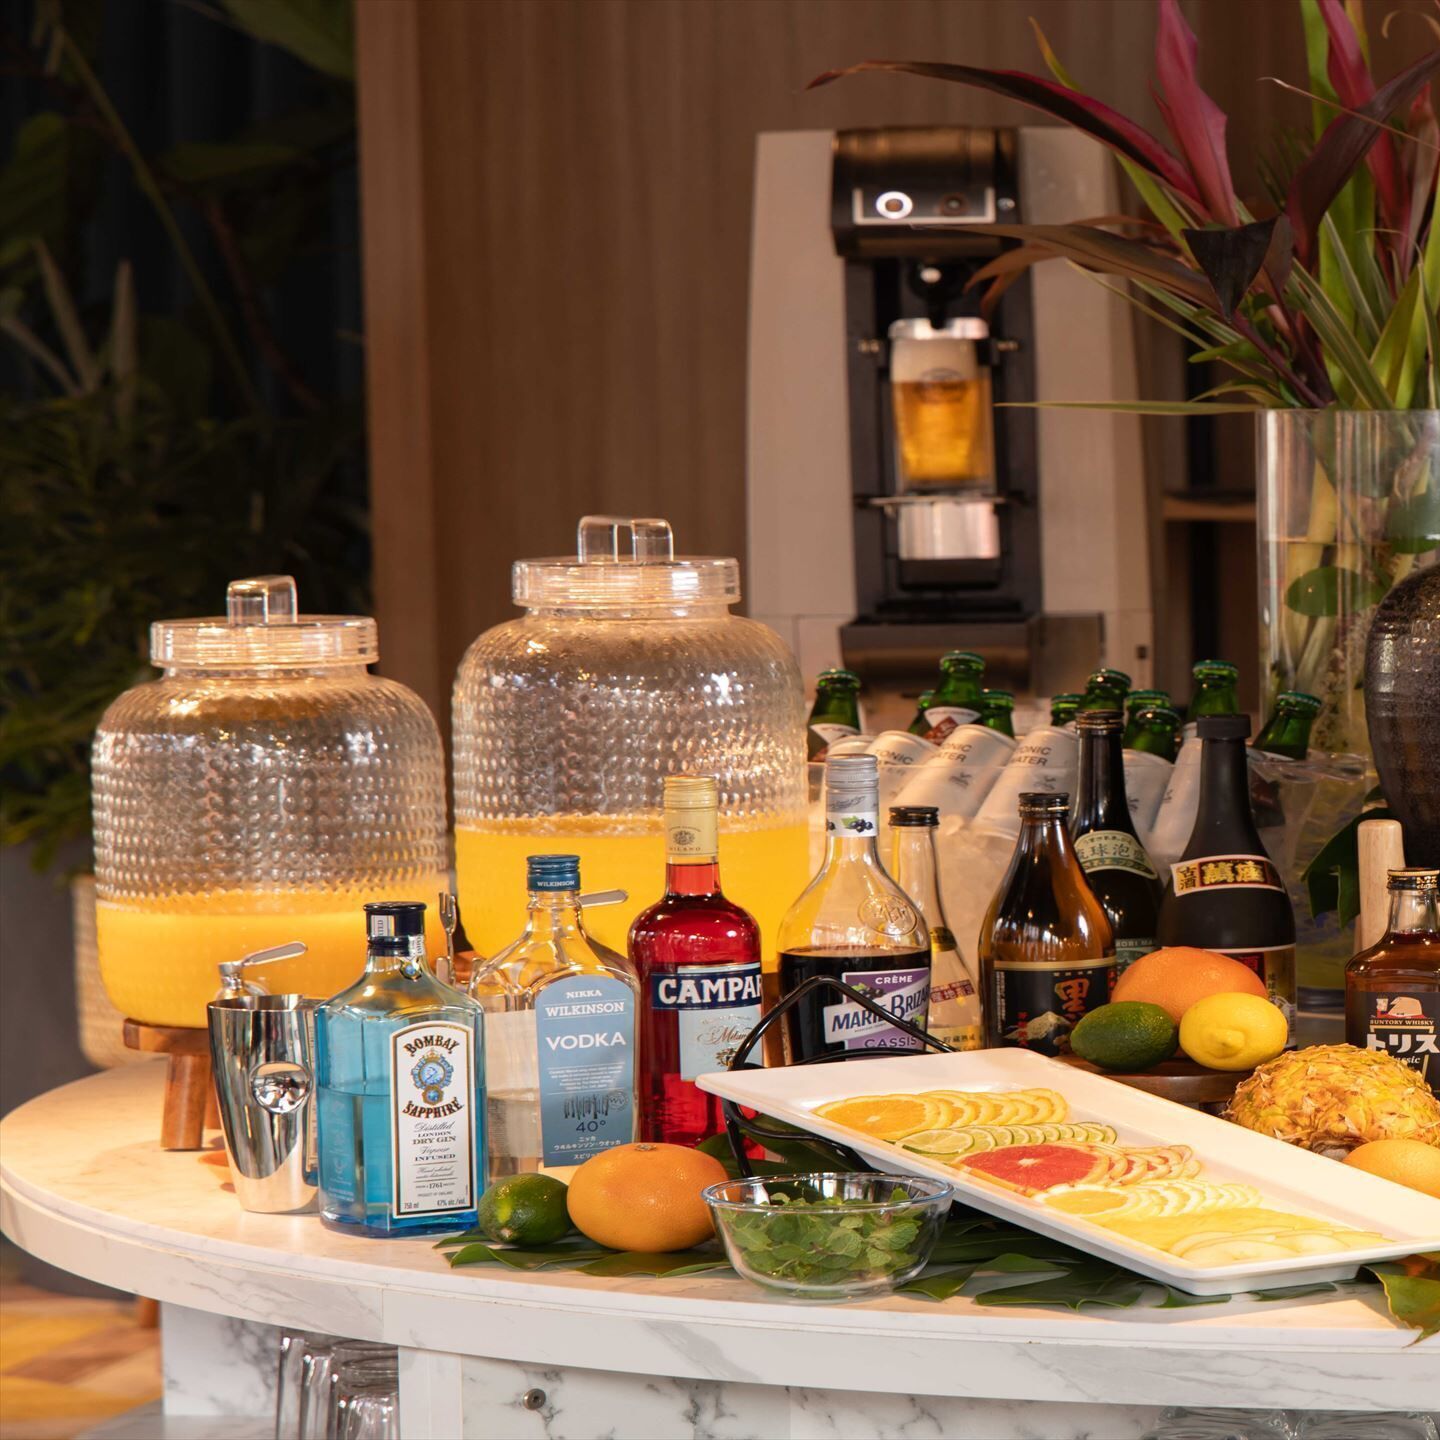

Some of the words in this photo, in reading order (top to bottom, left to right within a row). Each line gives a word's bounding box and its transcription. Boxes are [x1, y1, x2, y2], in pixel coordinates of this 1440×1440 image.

[875, 975, 913, 985] CRÈME
[566, 989, 602, 999] NIKKA
[545, 1002, 625, 1017] WILKINSON
[403, 1035, 459, 1057] BOMBAY
[546, 1031, 626, 1050] VODKA
[864, 1036, 917, 1048] CASSIS
[1366, 1033, 1440, 1054] トリス
[402, 1097, 463, 1118] SAPPHIRE
[414, 1120, 455, 1132] Distilled
